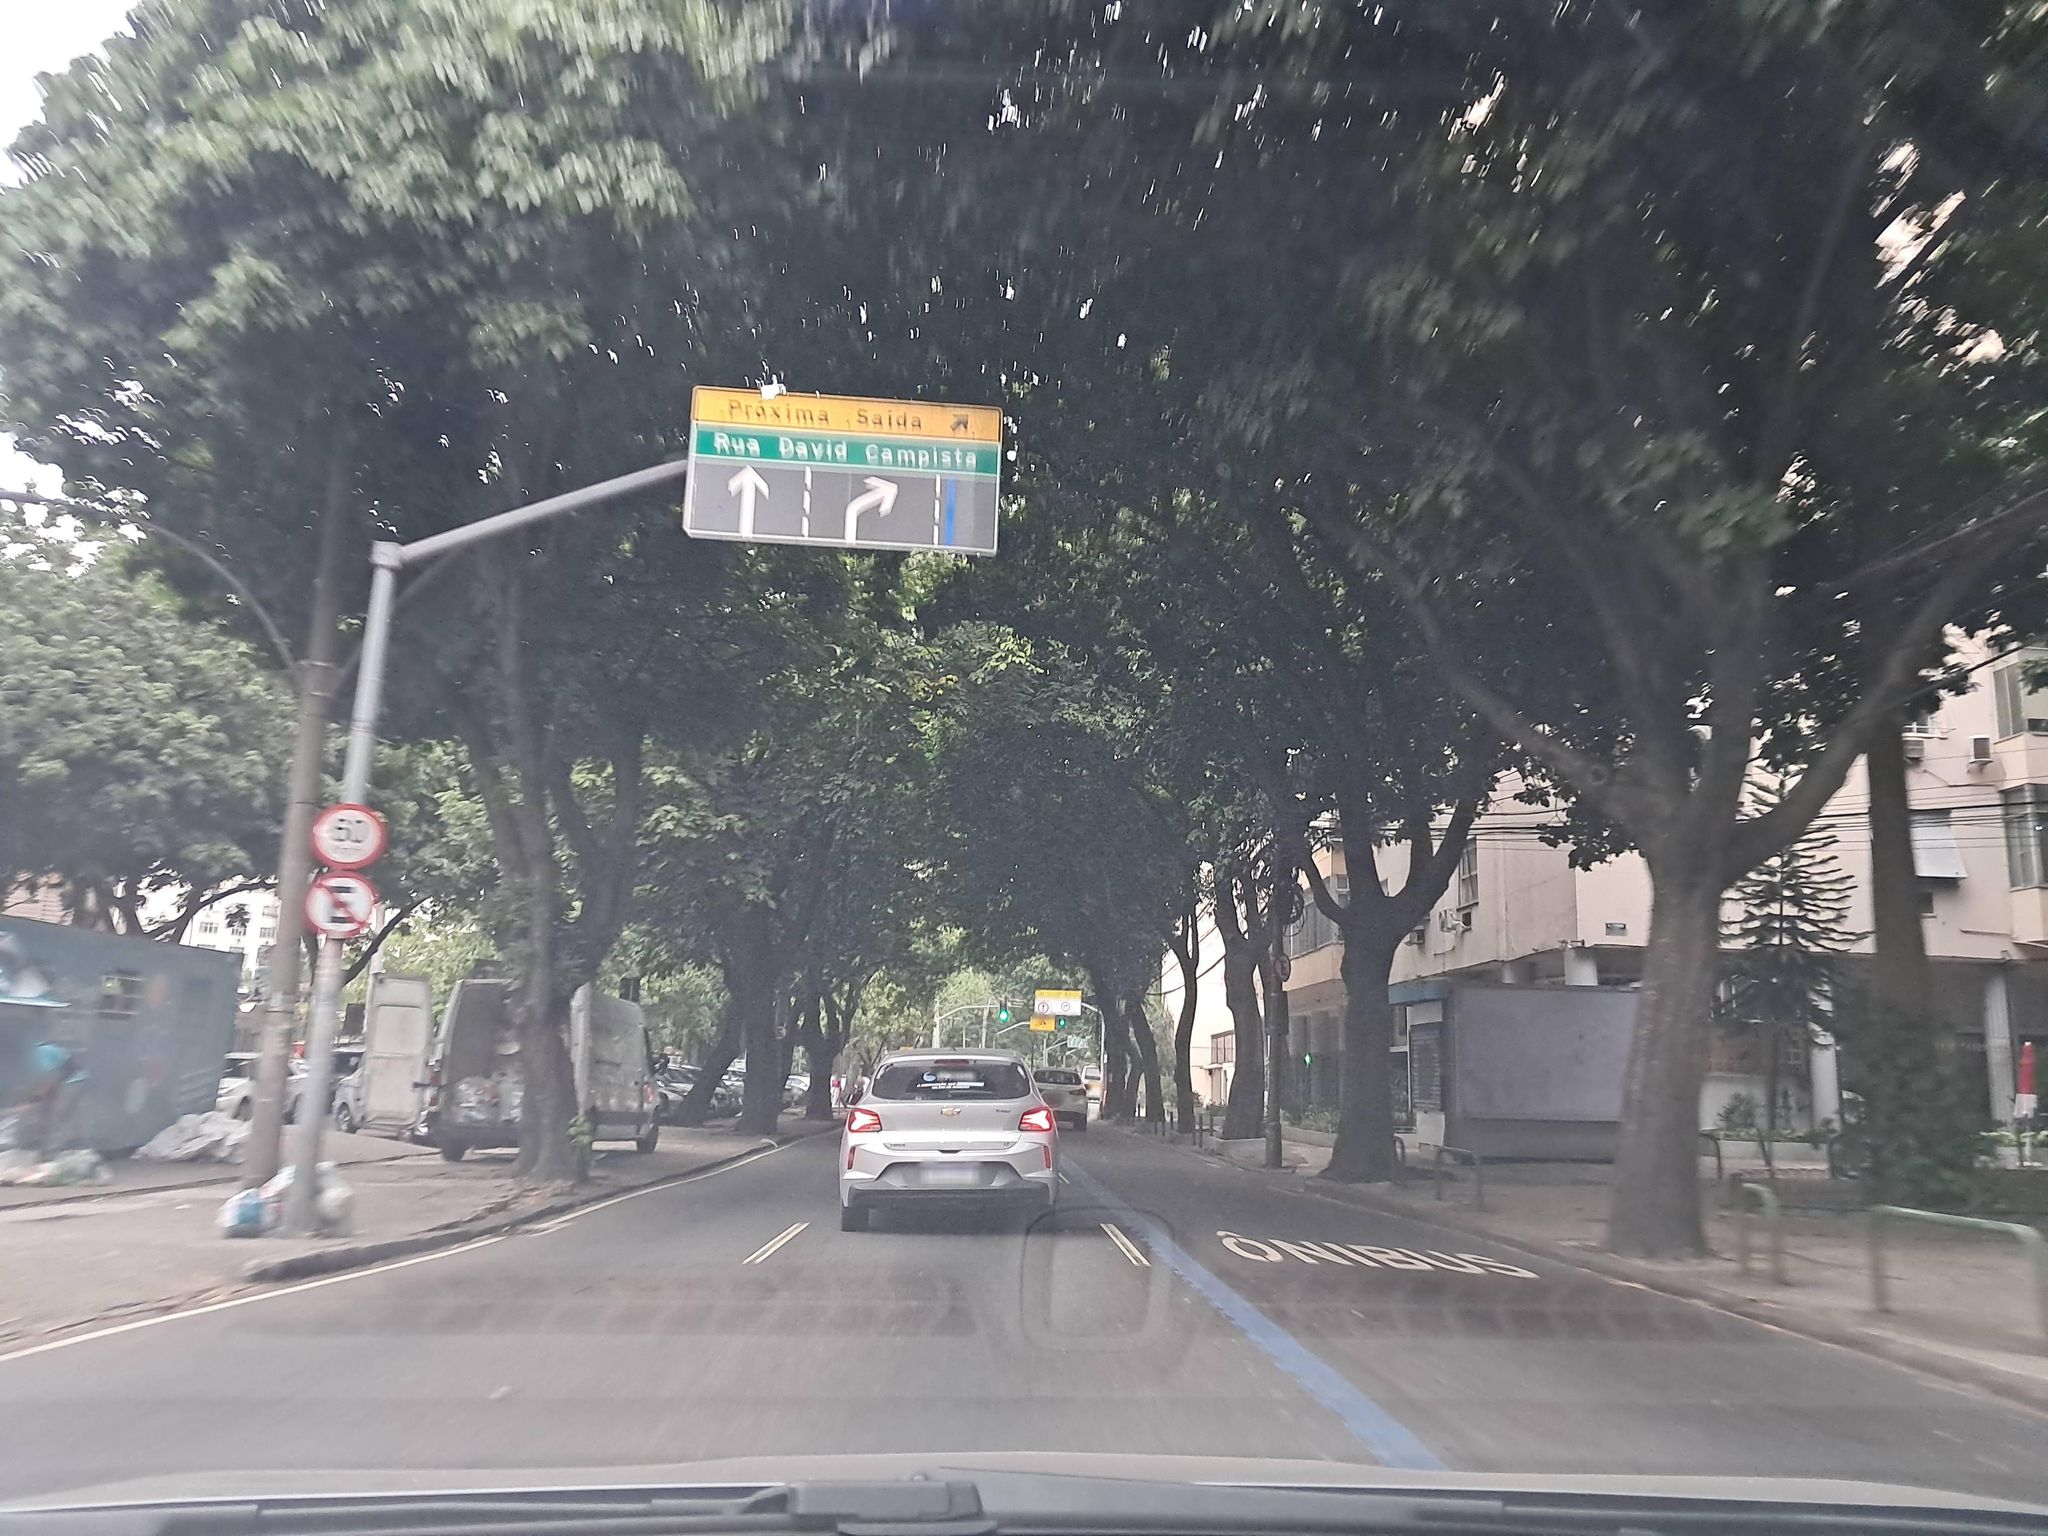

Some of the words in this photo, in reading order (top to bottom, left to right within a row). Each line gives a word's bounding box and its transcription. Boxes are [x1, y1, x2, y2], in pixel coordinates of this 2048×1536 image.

[727, 399, 830, 425] Próxima
[713, 431, 760, 457] Rua
[778, 436, 847, 462] David
[865, 443, 977, 470] Campista
